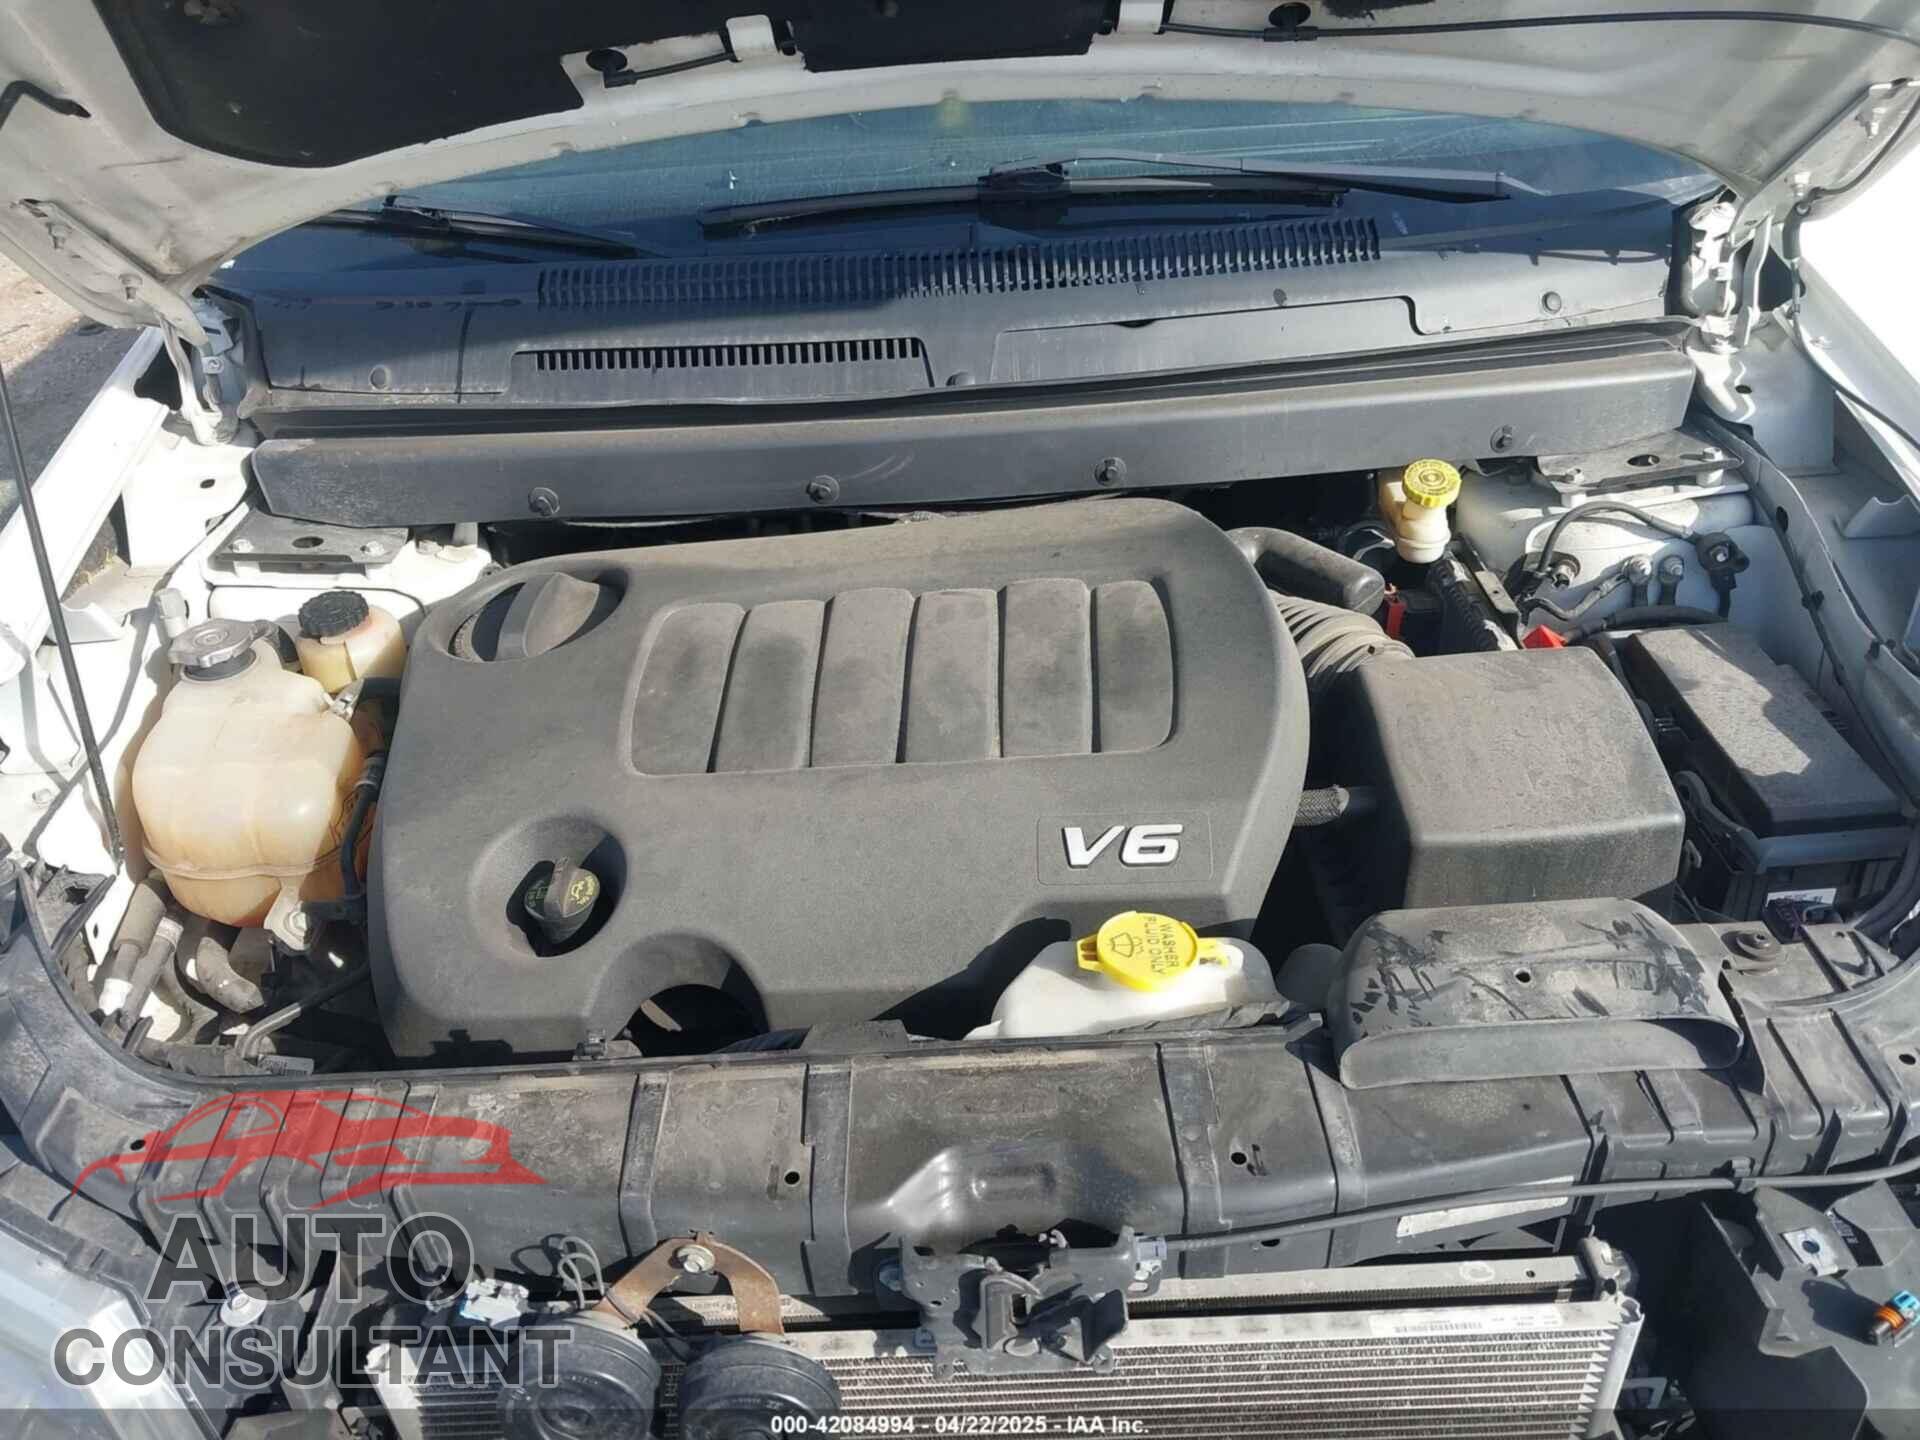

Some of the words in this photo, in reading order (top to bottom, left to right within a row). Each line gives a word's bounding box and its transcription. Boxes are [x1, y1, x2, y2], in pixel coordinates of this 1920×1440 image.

[1062, 824, 1183, 868] V6
[1144, 916, 1160, 944] FLUID
[1160, 923, 1179, 968] WASHER
[1149, 950, 1166, 975] ONLY
